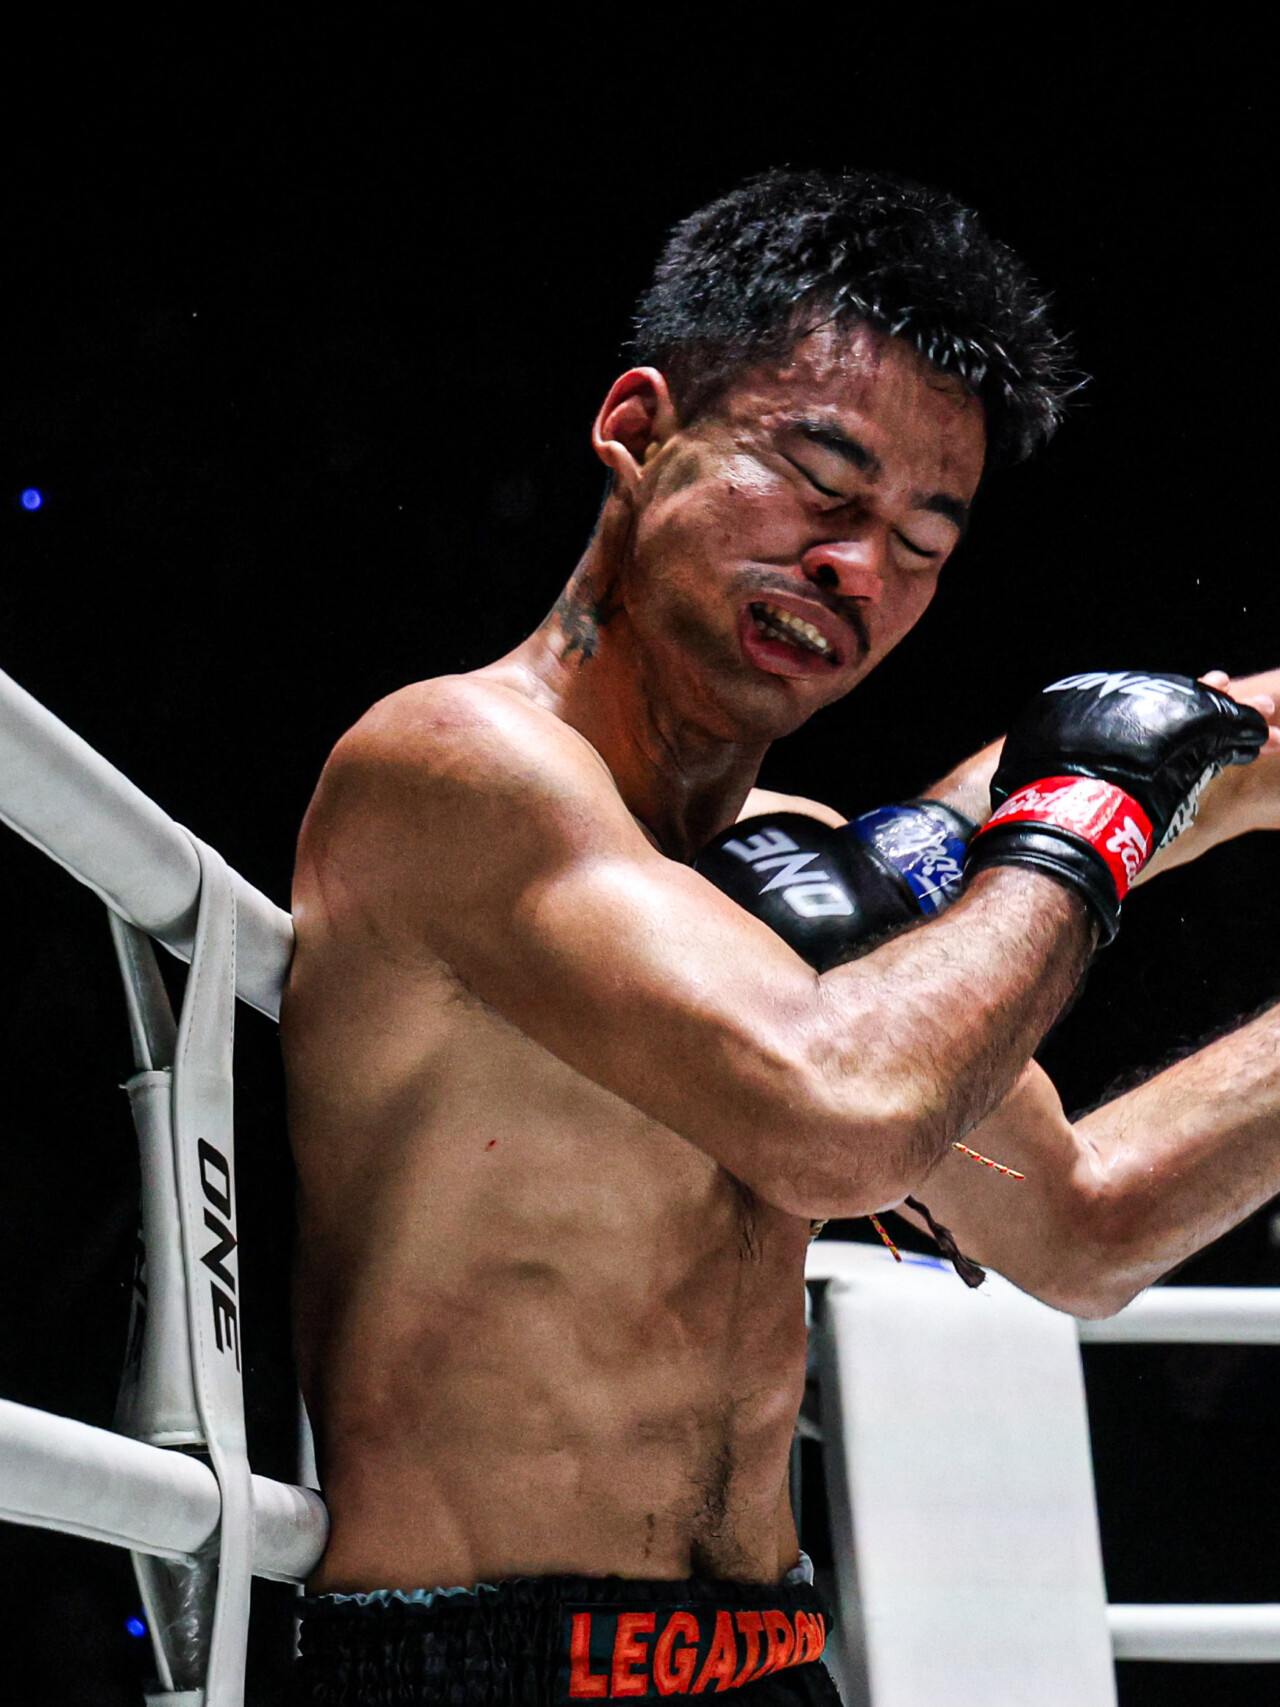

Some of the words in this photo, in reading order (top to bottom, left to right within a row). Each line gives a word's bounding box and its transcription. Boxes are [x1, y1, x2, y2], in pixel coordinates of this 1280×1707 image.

[1041, 670, 1196, 700] ONE
[721, 827, 855, 918] ONE
[197, 1136, 241, 1374] ONE
